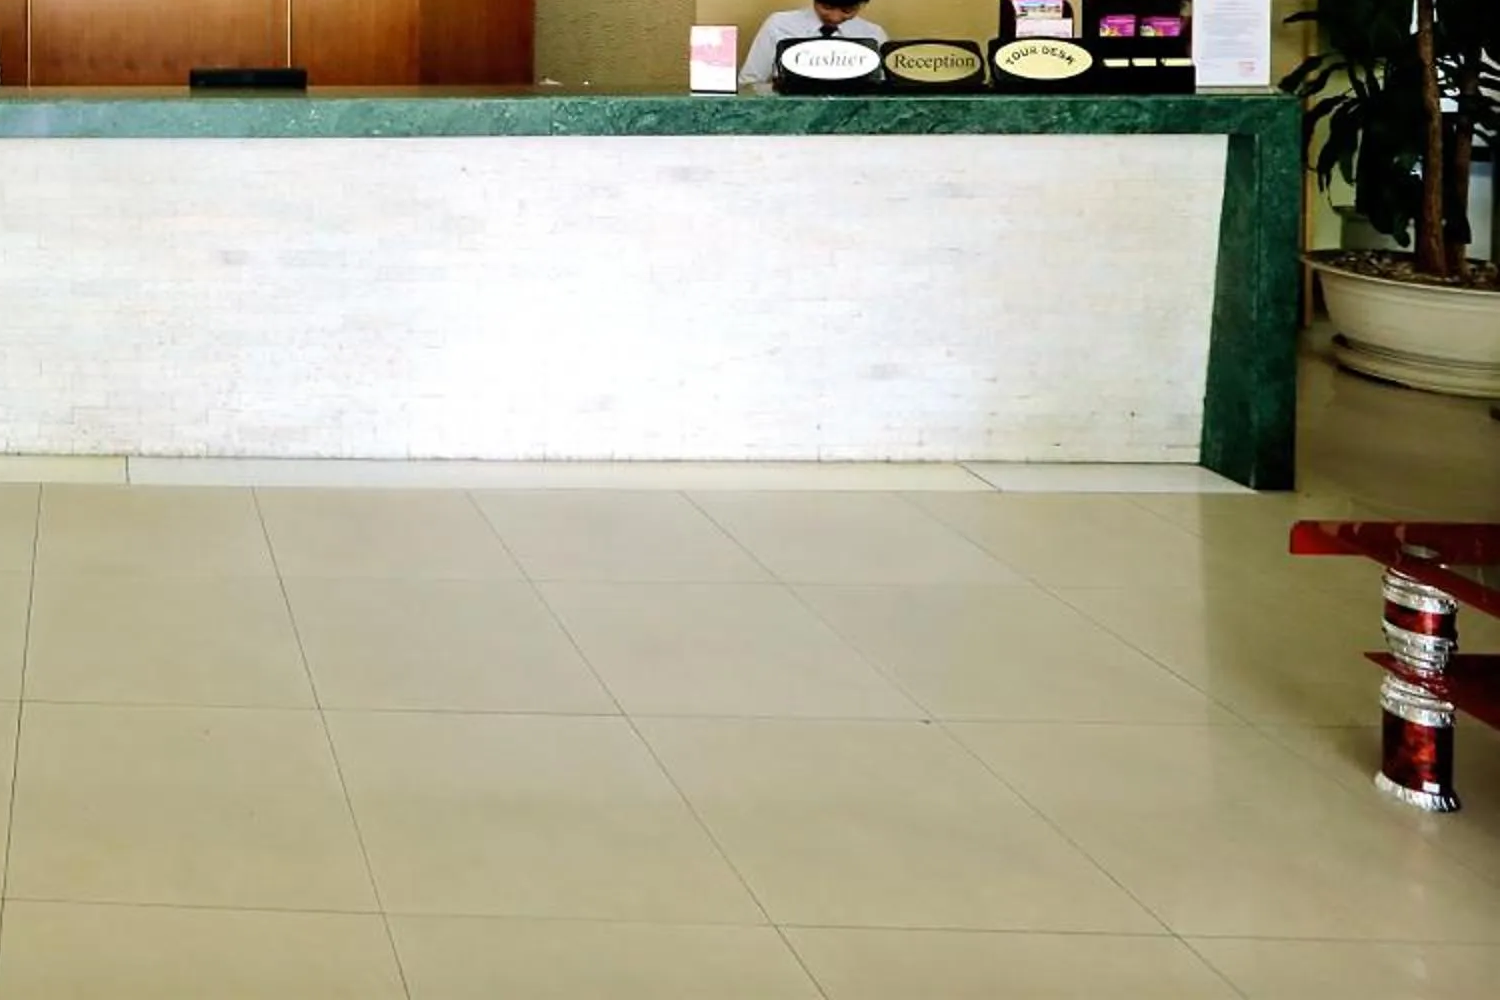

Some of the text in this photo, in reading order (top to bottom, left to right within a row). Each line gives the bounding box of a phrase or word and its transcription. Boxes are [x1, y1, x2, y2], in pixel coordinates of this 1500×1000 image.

[794, 49, 868, 68] Cashier
[894, 52, 976, 71] Reception
[1005, 45, 1076, 67] TOUR DESK
